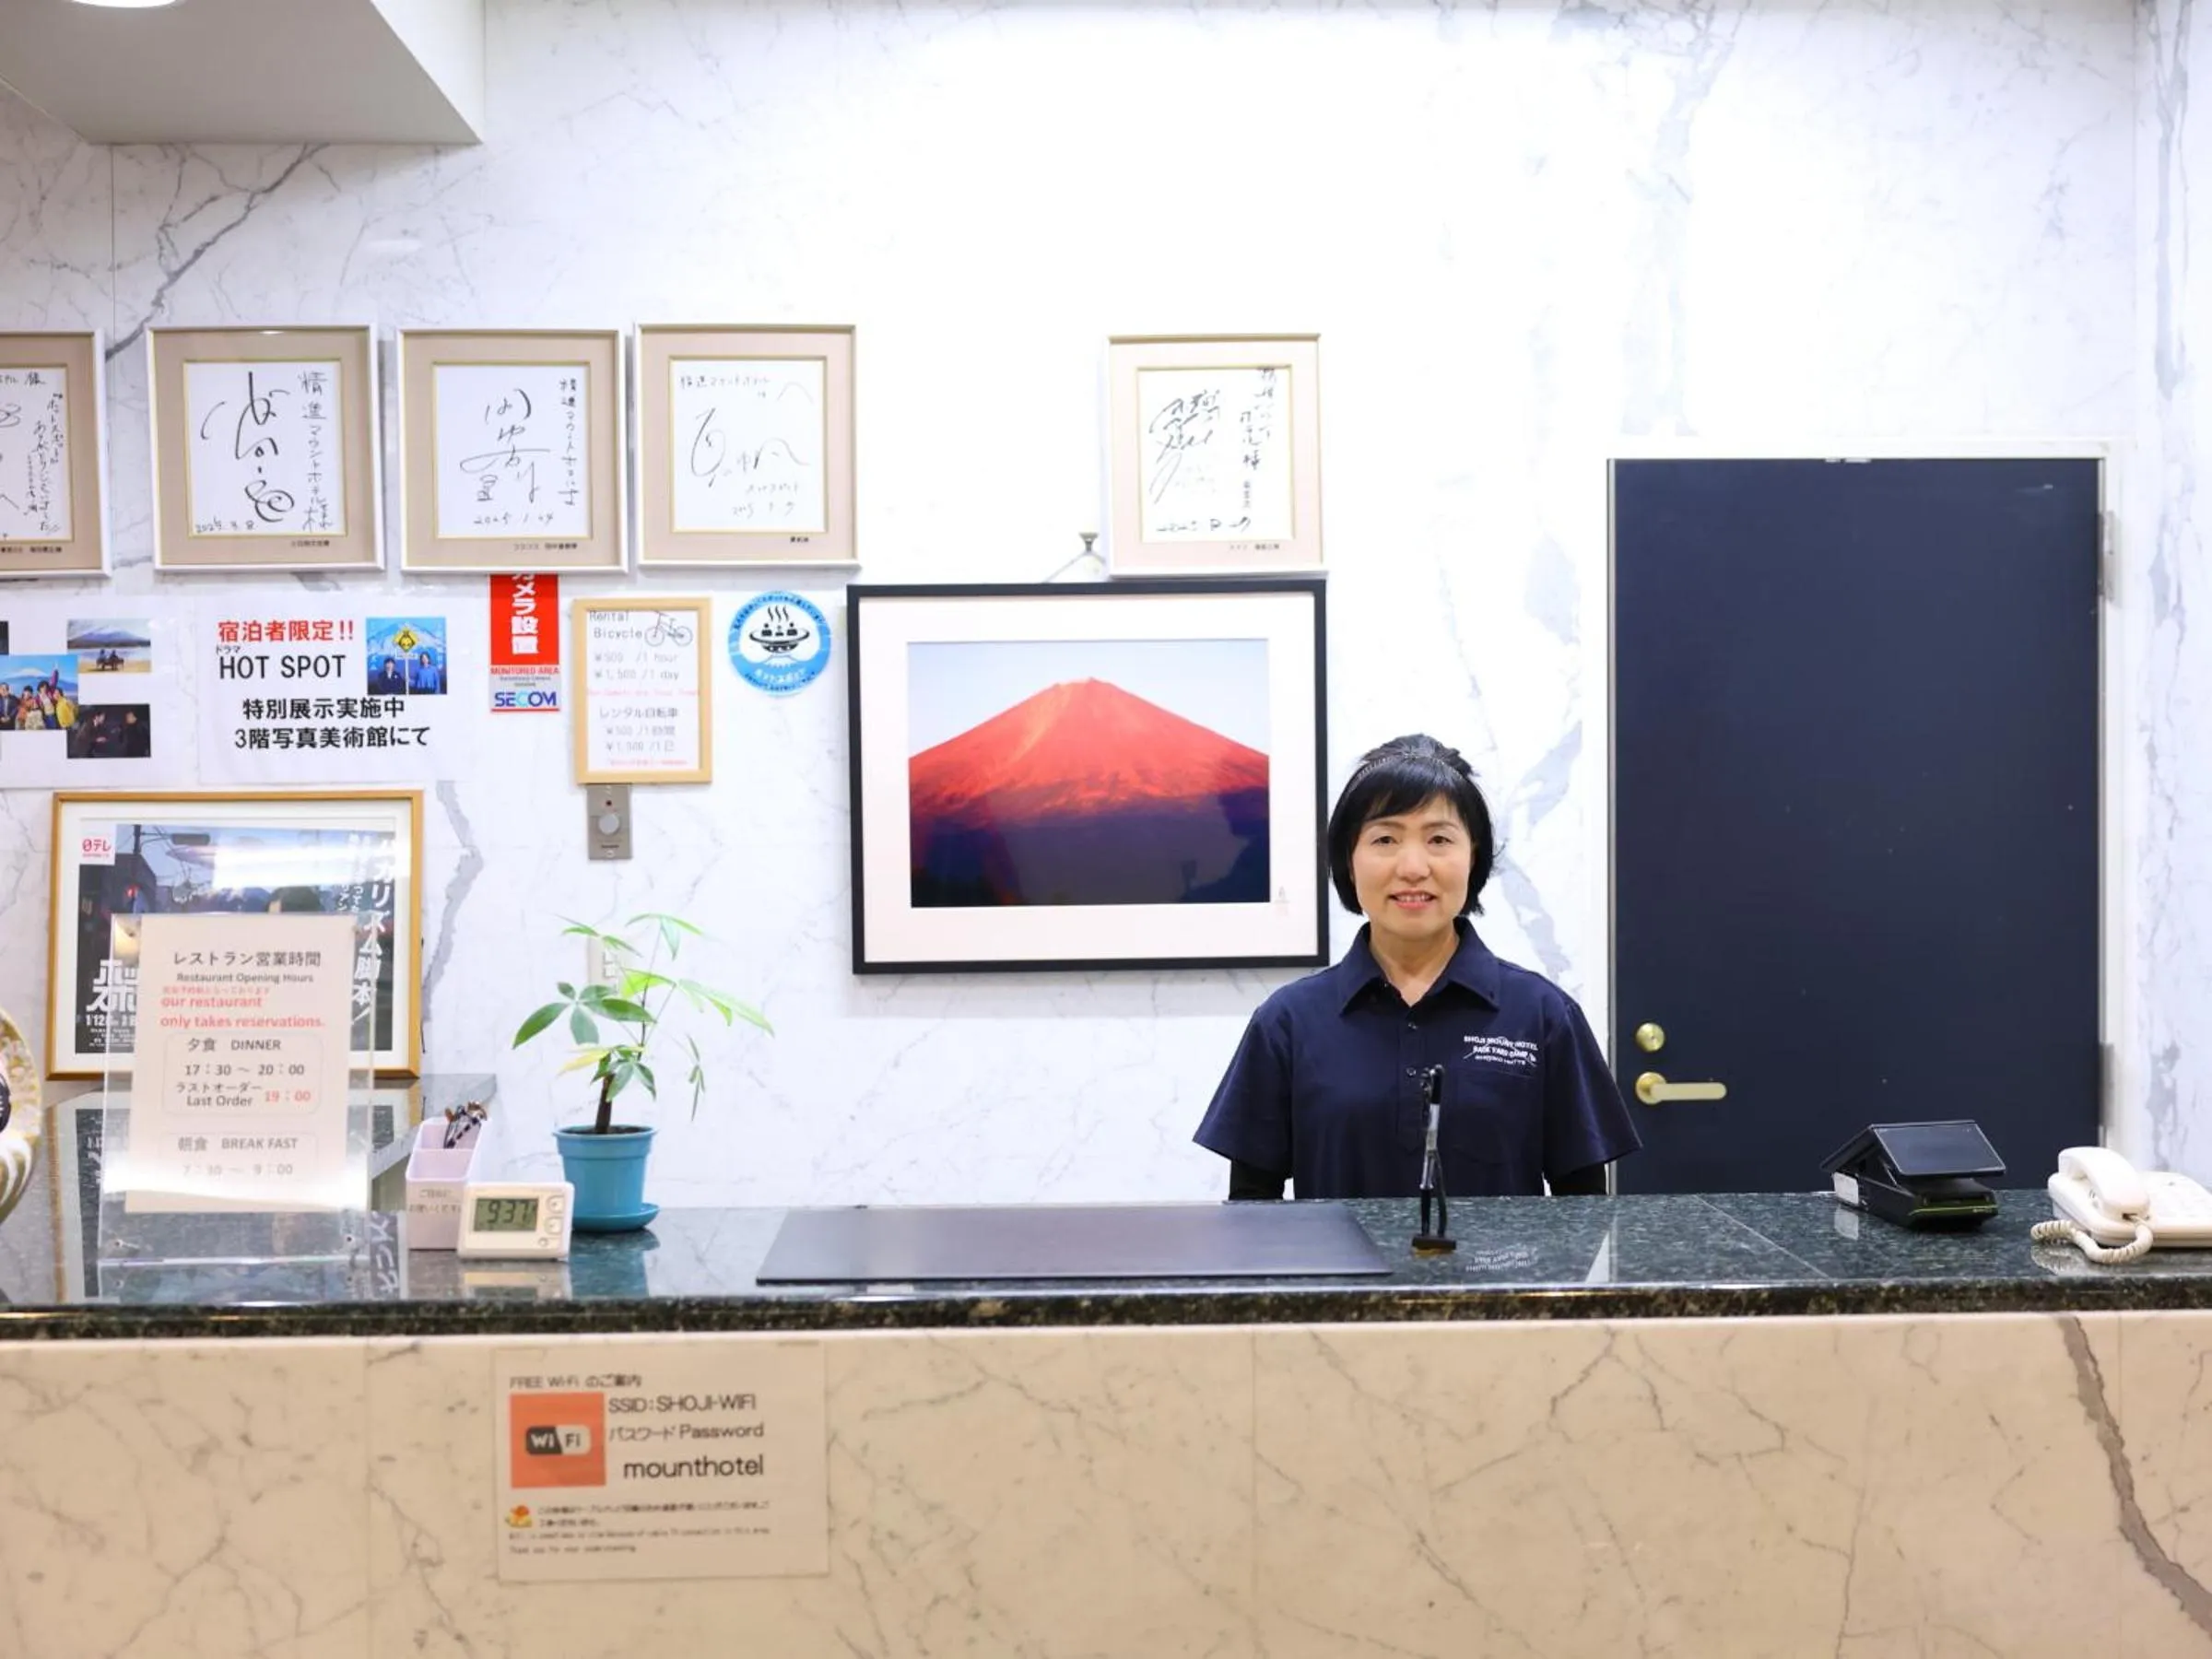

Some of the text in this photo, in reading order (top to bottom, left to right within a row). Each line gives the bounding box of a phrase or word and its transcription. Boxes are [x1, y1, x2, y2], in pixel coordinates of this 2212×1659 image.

[589, 610, 629, 622] Rental
[218, 620, 355, 642] 宿泊者限定!!
[594, 627, 643, 639] Bicycle
[216, 644, 241, 654] ドラマ
[654, 653, 678, 663] hour
[218, 654, 347, 679] HOT SPOT
[660, 670, 680, 681] day
[494, 690, 558, 707] SECOM
[242, 698, 406, 721] 特別展示実施中
[234, 725, 431, 749] 3階写真美術館にて
[82, 839, 112, 853] 日テレ
[173, 951, 322, 968] レストラン営業時間
[177, 972, 314, 984] Restaurant Opening Hours
[160, 996, 263, 1007] our restaurant
[159, 1015, 325, 1029] only takes reservations.
[187, 1037, 281, 1053] 夕食 DINNER
[175, 1081, 263, 1094] ラストオーダー
[186, 1095, 211, 1106] Last
[216, 1095, 253, 1107] Order
[221, 1137, 264, 1150] BREAK
[267, 1137, 299, 1150] FAST
[510, 1377, 543, 1389] FREE
[609, 1422, 765, 1441] パスワード Password
[622, 1453, 765, 1479] mounthotel
